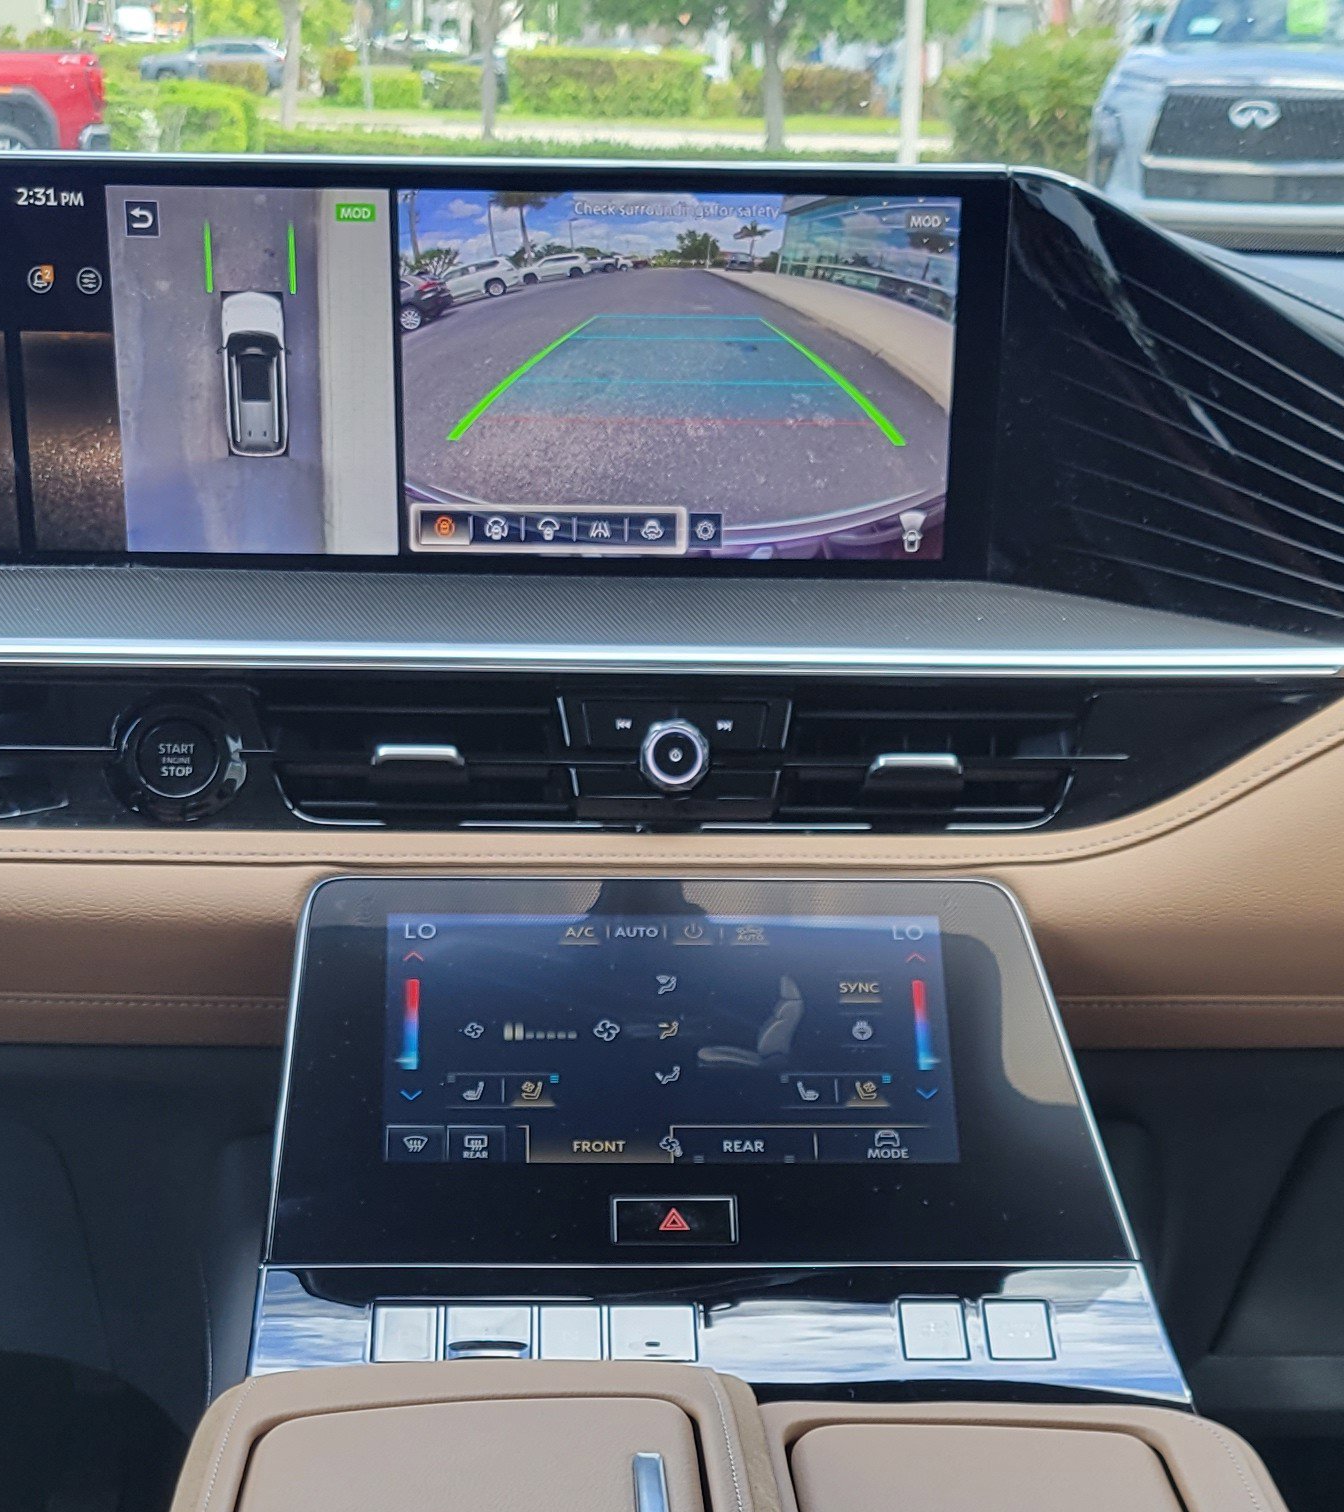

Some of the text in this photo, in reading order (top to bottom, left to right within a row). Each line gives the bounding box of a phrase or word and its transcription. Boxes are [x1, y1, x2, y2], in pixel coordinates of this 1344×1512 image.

[16, 188, 85, 207] 2:31 PM
[341, 207, 372, 219] MOD
[574, 201, 780, 219] Check surroundings for safety
[910, 214, 942, 228] MOD
[158, 743, 195, 754] START
[161, 767, 193, 777] STOP
[404, 923, 437, 940] LO
[565, 926, 595, 939] A/C
[614, 926, 658, 939] AUTO
[892, 925, 924, 941] LO
[839, 981, 880, 994] SYNC
[572, 1140, 626, 1153] FRONT
[722, 1140, 765, 1153] REAR
[463, 1150, 488, 1160] REAR
[867, 1148, 910, 1160] MODE
